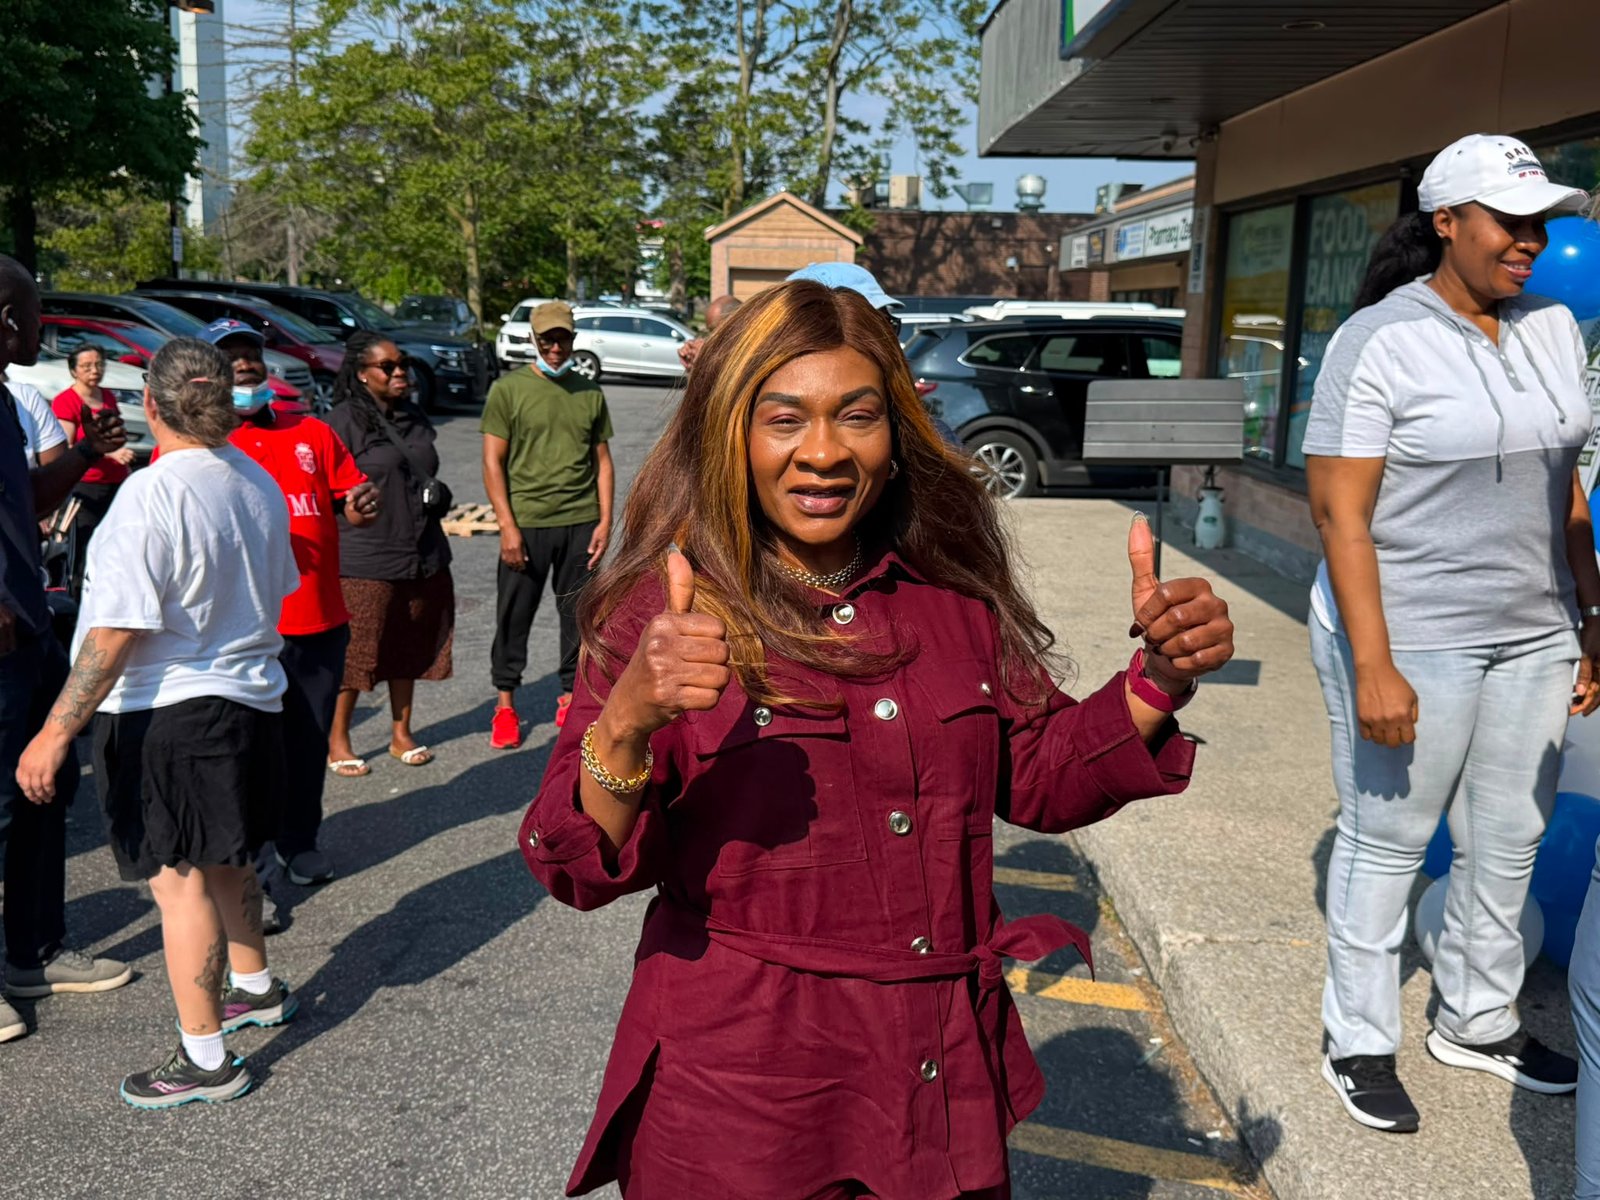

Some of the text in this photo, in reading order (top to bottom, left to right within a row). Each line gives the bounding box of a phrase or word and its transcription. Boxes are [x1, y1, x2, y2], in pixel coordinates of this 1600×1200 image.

[1504, 147, 1532, 160] OAS
[1148, 224, 1179, 249] Pharmacy
[1310, 206, 1368, 253] FOOD
[1304, 256, 1362, 306] BANK
